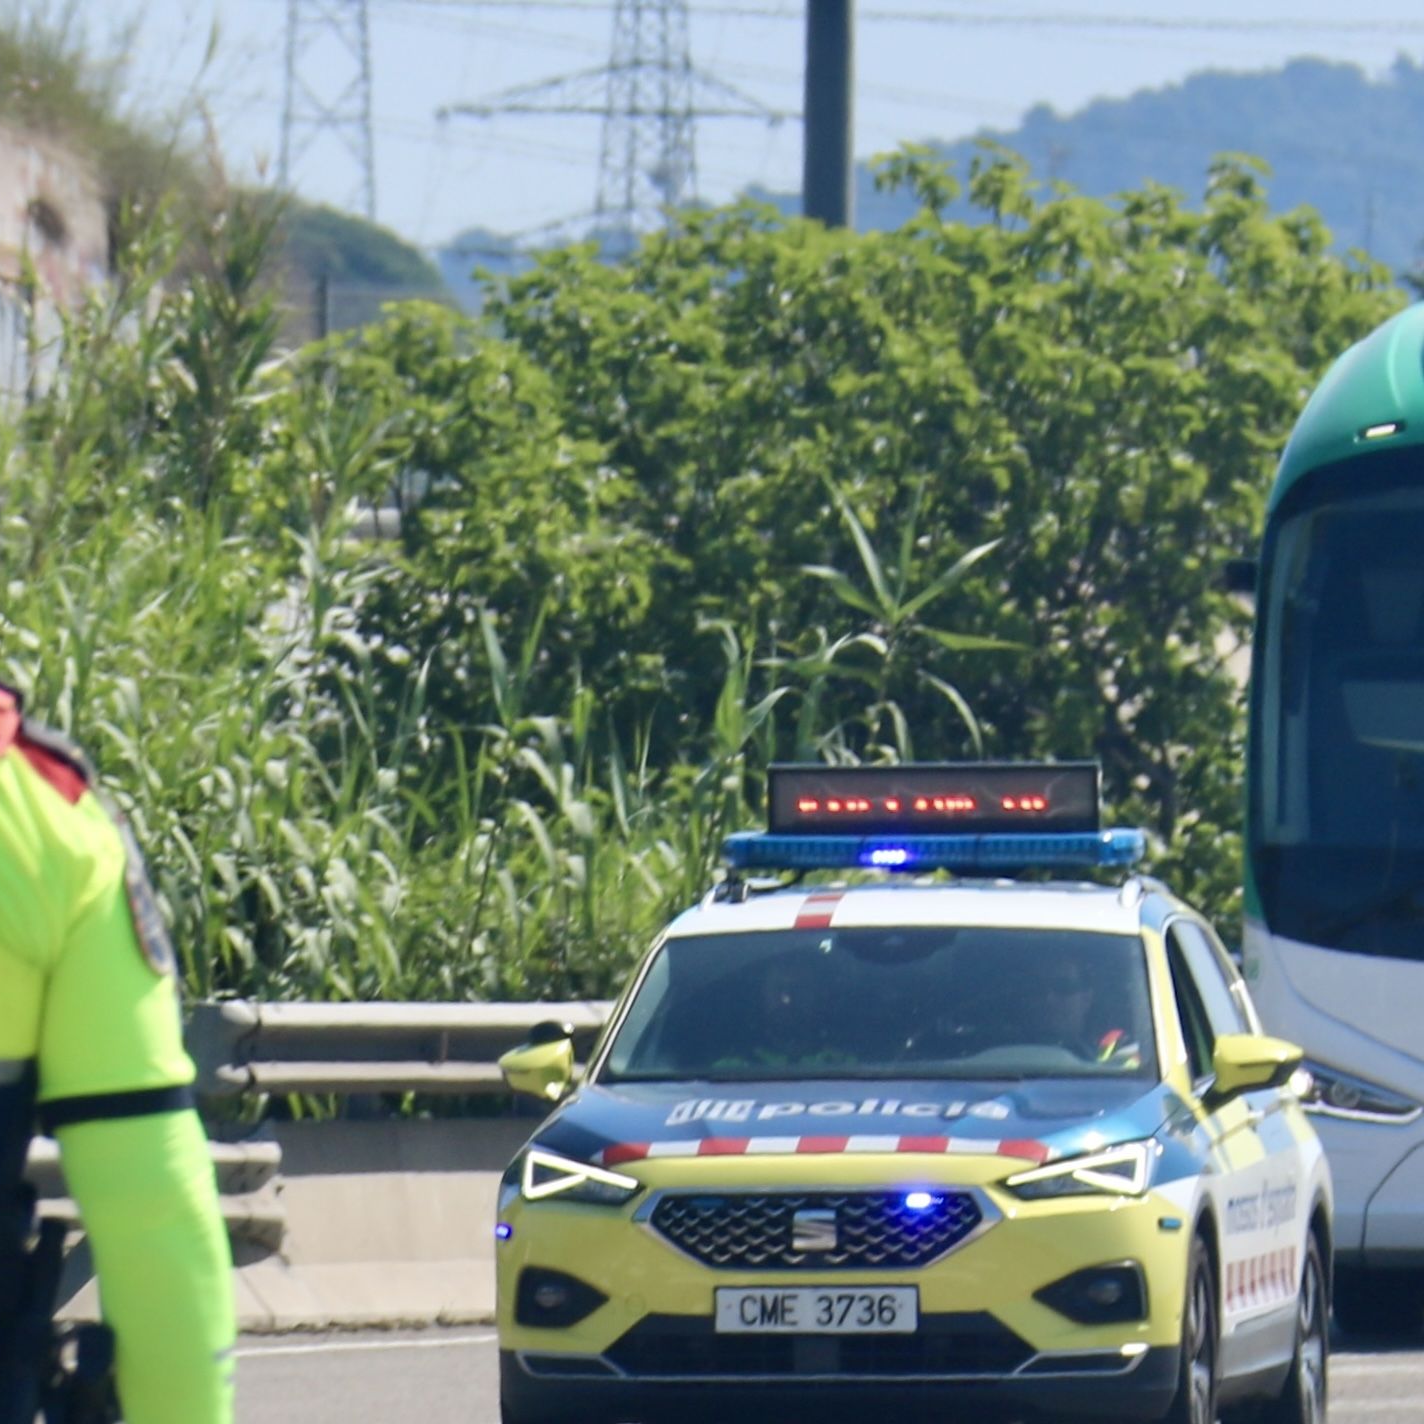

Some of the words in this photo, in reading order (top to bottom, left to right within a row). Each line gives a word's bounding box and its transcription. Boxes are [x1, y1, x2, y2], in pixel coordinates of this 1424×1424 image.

[756, 1097, 1010, 1121] policia
[739, 1293, 800, 1327] CME
[815, 1293, 897, 1327] 3736
